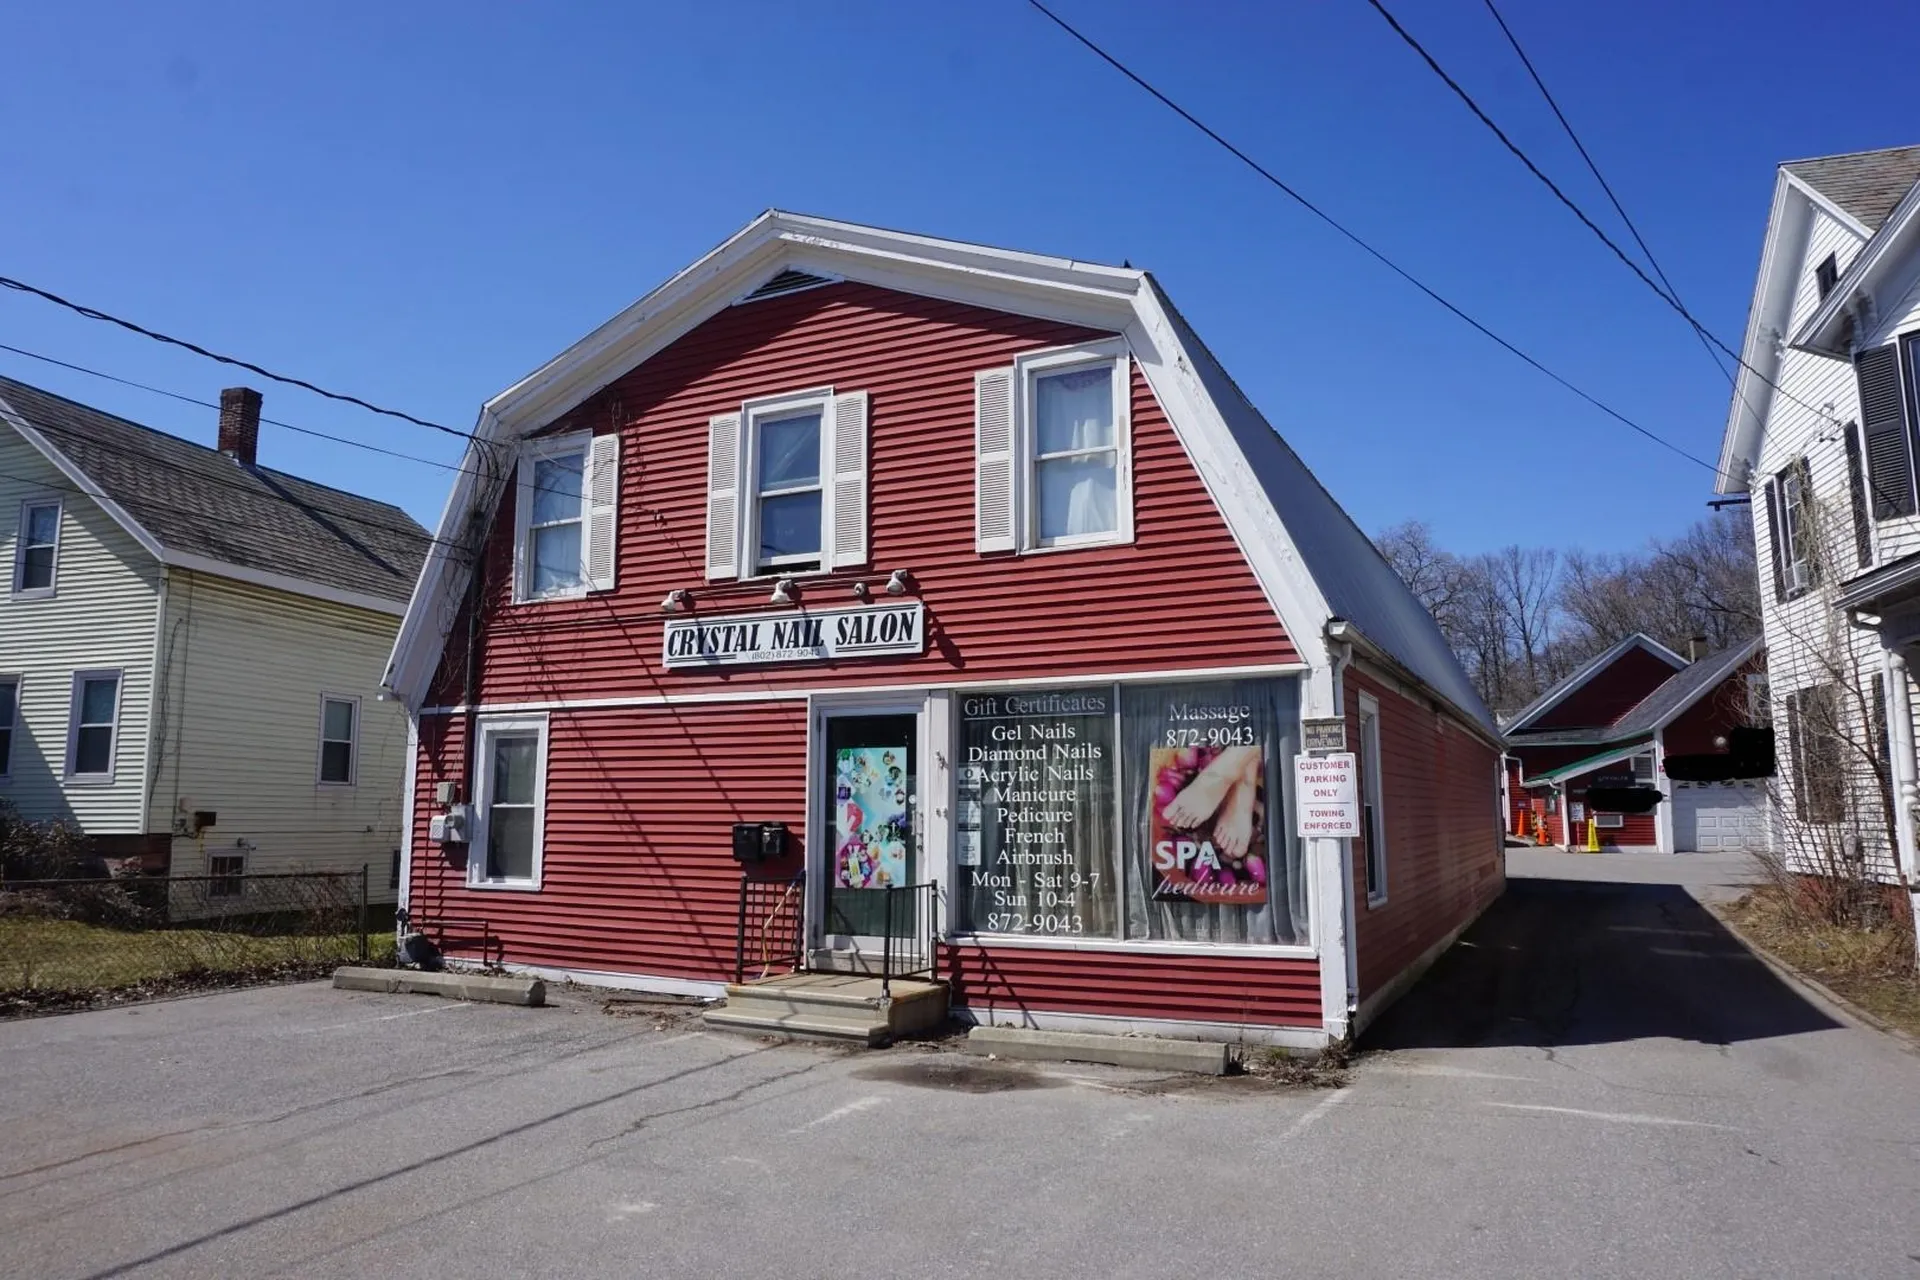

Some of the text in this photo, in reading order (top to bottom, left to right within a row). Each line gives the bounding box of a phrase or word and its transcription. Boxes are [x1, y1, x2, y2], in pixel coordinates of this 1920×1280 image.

[667, 611, 917, 657] CRYSTAL NAIL SALON
[964, 695, 1106, 716] Gift Certificates
[1169, 704, 1251, 723] Massage
[992, 723, 1076, 741] Gel Nails
[1166, 727, 1254, 747] 872-9043
[969, 742, 1102, 762] Diamond Nails
[1299, 760, 1350, 770] CUSTOMER
[978, 765, 1094, 785] Acrylic Nails
[1304, 774, 1347, 783] PARKING
[993, 786, 1077, 802] Manicure
[1313, 789, 1338, 797] ONLY
[997, 808, 1074, 823] Pedicure
[1309, 810, 1345, 818] TOWING
[1304, 822, 1352, 830] ENFORCED
[1005, 828, 1066, 844] French
[996, 849, 1074, 865] Airbrush
[1155, 841, 1221, 870] SPA
[972, 871, 1012, 887] Mon
[1034, 871, 1062, 888] Sat
[1070, 871, 1100, 889] 9-7
[1151, 869, 1260, 900] pedicure
[994, 890, 1076, 908] Sun 10-4
[988, 912, 1083, 933] 872-9043
